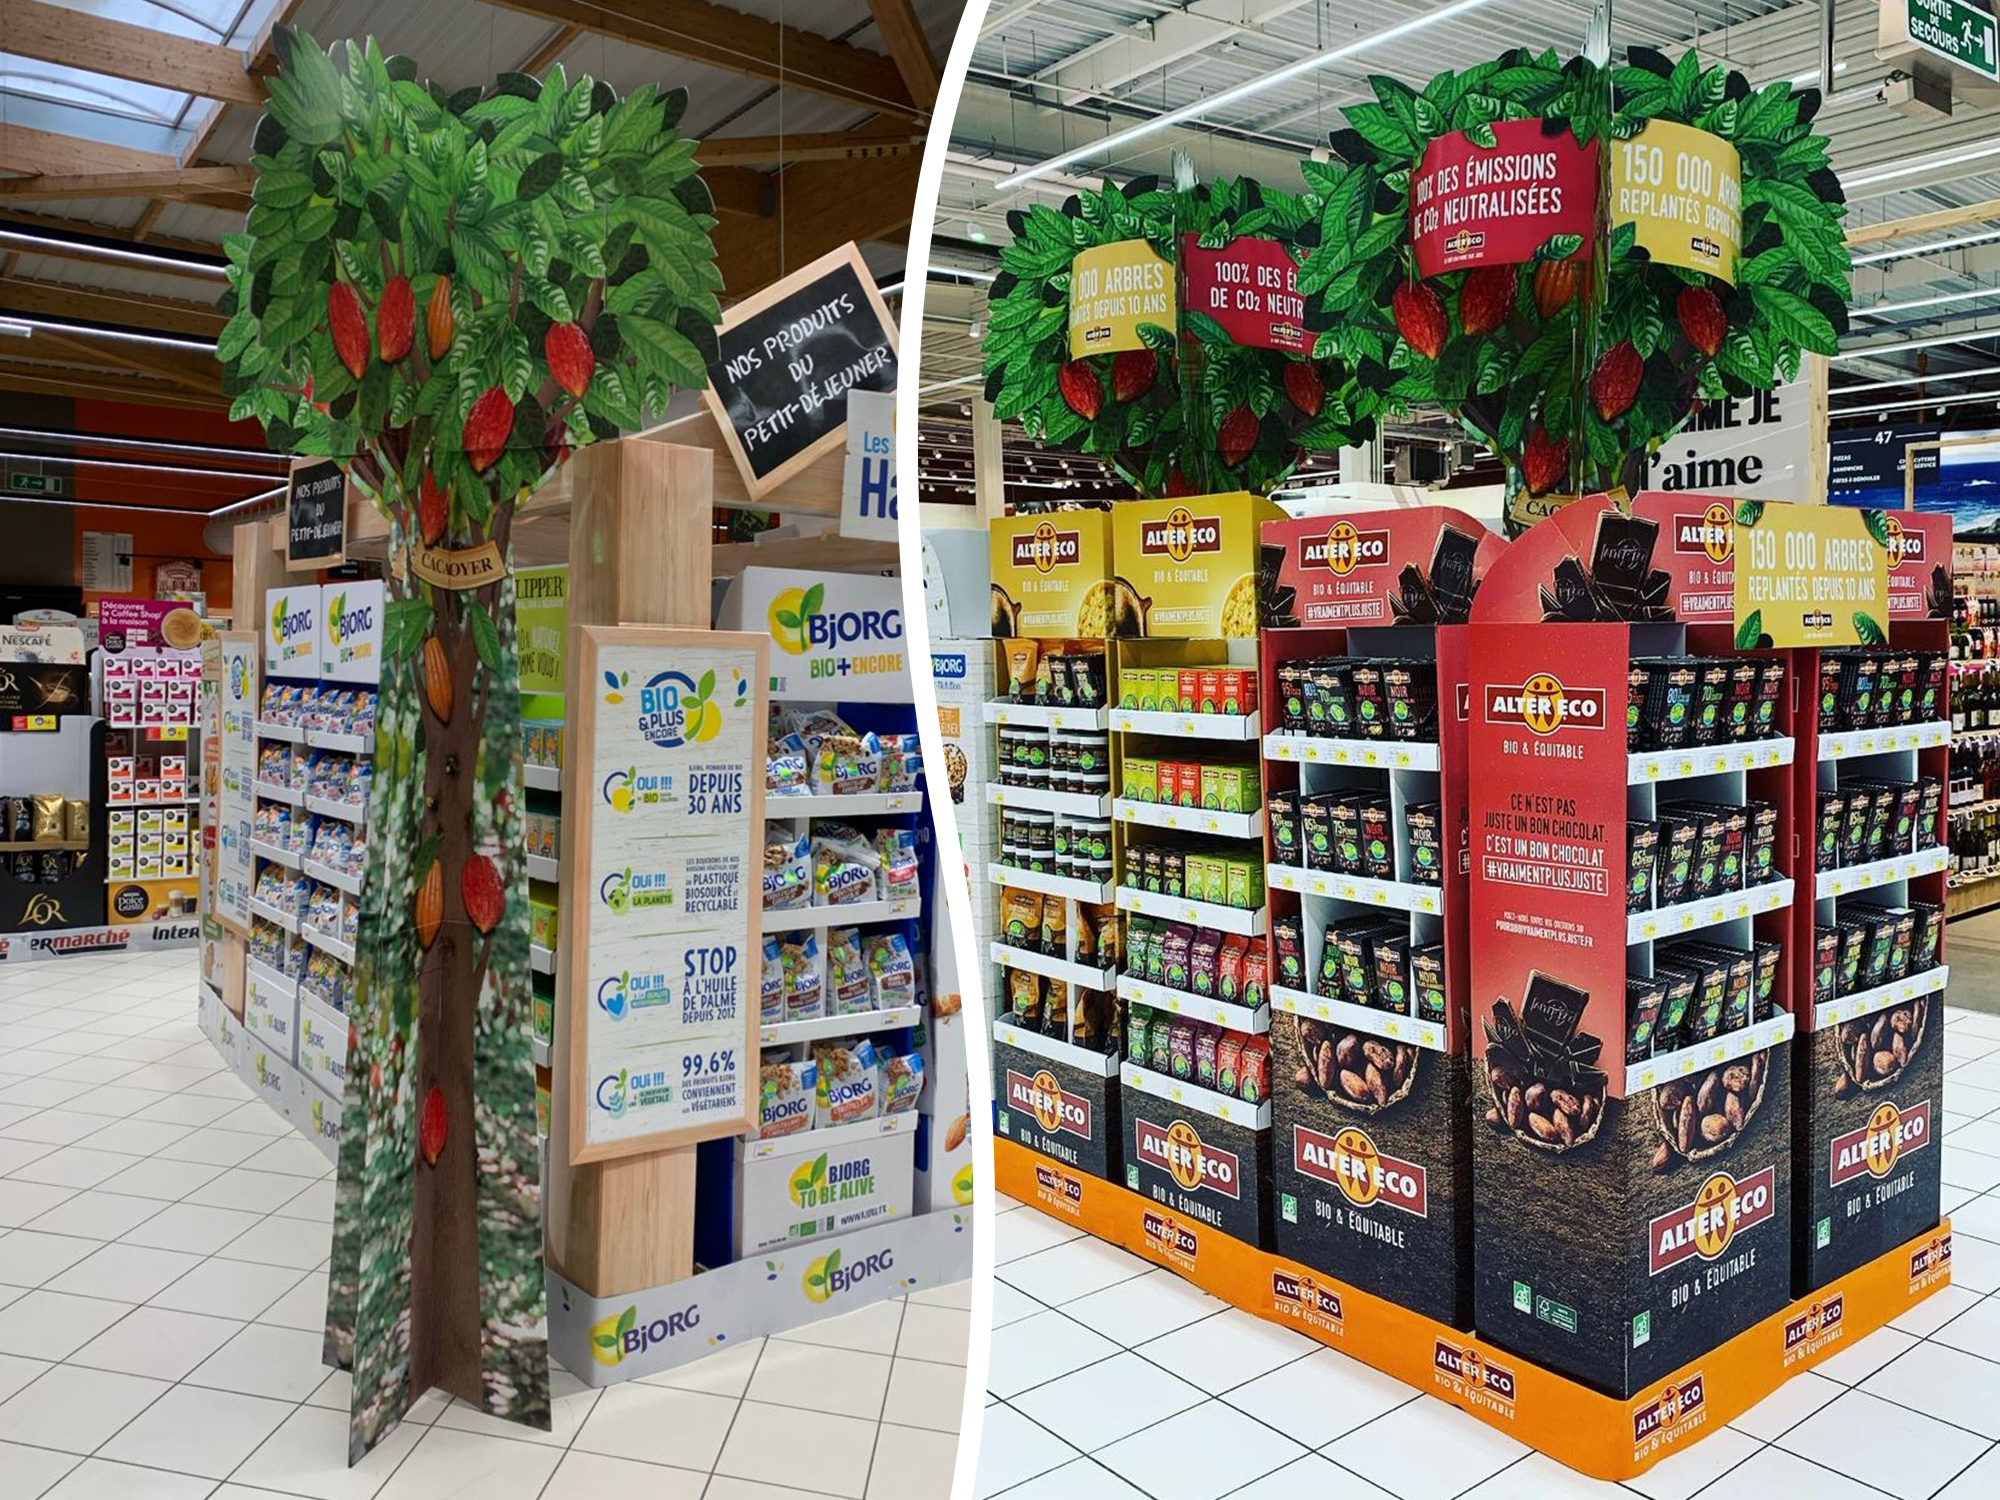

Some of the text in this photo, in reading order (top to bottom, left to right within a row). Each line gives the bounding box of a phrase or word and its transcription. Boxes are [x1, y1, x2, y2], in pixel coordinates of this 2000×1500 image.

[1930, 14, 1939, 27] DE
[1911, 17, 1959, 54] SECOURS
[1438, 152, 1558, 194] DES ÉMISSIONS
[1623, 143, 1712, 197] 150 000
[1443, 186, 1562, 225] NEUTRALISÉES
[1620, 188, 1700, 224] REPLANTÉS
[1105, 262, 1163, 294] ARBRES
[1215, 262, 1281, 288] 100% DES
[1094, 297, 1125, 319] DEPUIS
[1128, 295, 1140, 315] 10
[1144, 294, 1166, 313] ANS
[1210, 287, 1228, 308] DE
[724, 292, 854, 384] NOS PRODUITS
[788, 354, 814, 382] DU
[744, 346, 891, 450] PETIT-DÉJEUNER
[864, 431, 889, 452] Les
[1875, 431, 1892, 444] 47
[296, 484, 311, 499] NOS
[316, 503, 325, 516] DU
[1146, 527, 1216, 546] ALTER ECO
[1680, 526, 1725, 543] ALTER
[1900, 539, 1921, 553] ECO
[1016, 541, 1075, 558] ALTER ECO
[1305, 541, 1383, 560] ALTER ECO
[1749, 529, 1873, 572] 150 000 ARBRES
[422, 553, 493, 576] CACAOYER
[1313, 581, 1373, 595] BIO ÉQUITABLE
[1689, 571, 1700, 584] BIO
[1749, 572, 1875, 601] REPLANTÉS DEPUIS 10 ANS
[102, 601, 145, 609] Découvrez
[2, 634, 52, 646] NESCAFÉ
[641, 685, 679, 714] BIO
[1390, 686, 1407, 697] NOIR
[1492, 695, 1598, 718] ALTER ECO
[638, 710, 684, 731] & PLUS
[645, 728, 678, 741] ENCORE
[1503, 740, 1583, 759] BIO & ÉQUITABLE
[690, 773, 742, 793] DEPUIS
[644, 793, 658, 803] BIO
[688, 795, 706, 814] 30
[711, 794, 742, 814] ANS
[1511, 794, 1576, 817] CE PAS
[1413, 828, 1432, 842] NOIR
[1484, 812, 1608, 843] JUSTE UN BON CHOCOLAT.
[1486, 834, 1604, 867] C'EST UN BON CHOCOLAT
[693, 872, 739, 885] PLASTIQUE
[1487, 861, 1604, 891] #VRAIMENTPLUSJUSTE
[633, 898, 642, 906] LA
[686, 885, 731, 899] BIOSOURCÉ
[118, 903, 144, 911] Gusto
[686, 899, 738, 913] RECYCLABLE
[684, 946, 736, 977] STOP
[1380, 959, 1398, 974] NOIR
[683, 976, 736, 995] À L'HUILE
[1418, 970, 1438, 985] NOIR
[683, 996, 696, 1011] DE
[701, 992, 736, 1009] PALME
[683, 1007, 736, 1024] DEPUIS 2012
[682, 1083, 735, 1100] CONVIENNENT
[691, 1097, 736, 1112] VÉGÉTARIENS
[1012, 1083, 1085, 1126] ALTER ECO
[1021, 1129, 1077, 1165] BIO ÉQUITABLE
[1837, 1116, 1924, 1170] ALTER ECO
[1143, 1133, 1232, 1183] ALTER ECO
[1302, 1142, 1418, 1198] ALTER ECO
[829, 1158, 870, 1184] BJORG
[800, 1176, 875, 1209] TO BE ALIVE
[1847, 1171, 1914, 1217] BIO & ÉQUITABLE
[1152, 1184, 1222, 1227] BIO ÉQUITABLE
[1316, 1200, 1404, 1248] BIO & ÉQUITABLE
[1658, 1185, 1767, 1255] ALTER ECO
[1145, 1220, 1195, 1250] ALTER ECO
[1913, 1248, 1939, 1272] ALTER
[1671, 1248, 1756, 1308] BIO & ÉQUITABLE
[1276, 1280, 1339, 1315] ALTER ECO
[1275, 1301, 1344, 1337] BIO ÉQUITABLE
[1788, 1305, 1841, 1343] ALTER ECO
[1783, 1327, 1843, 1367] BIO ÉQUITABLE
[1438, 1350, 1511, 1392] ALTER ECO
[1434, 1374, 1515, 1419] BIO ÉQUITABLE
[1637, 1388, 1700, 1434] ALTER ECO
[1634, 1413, 1707, 1462] BIO ÉQUITABLE
